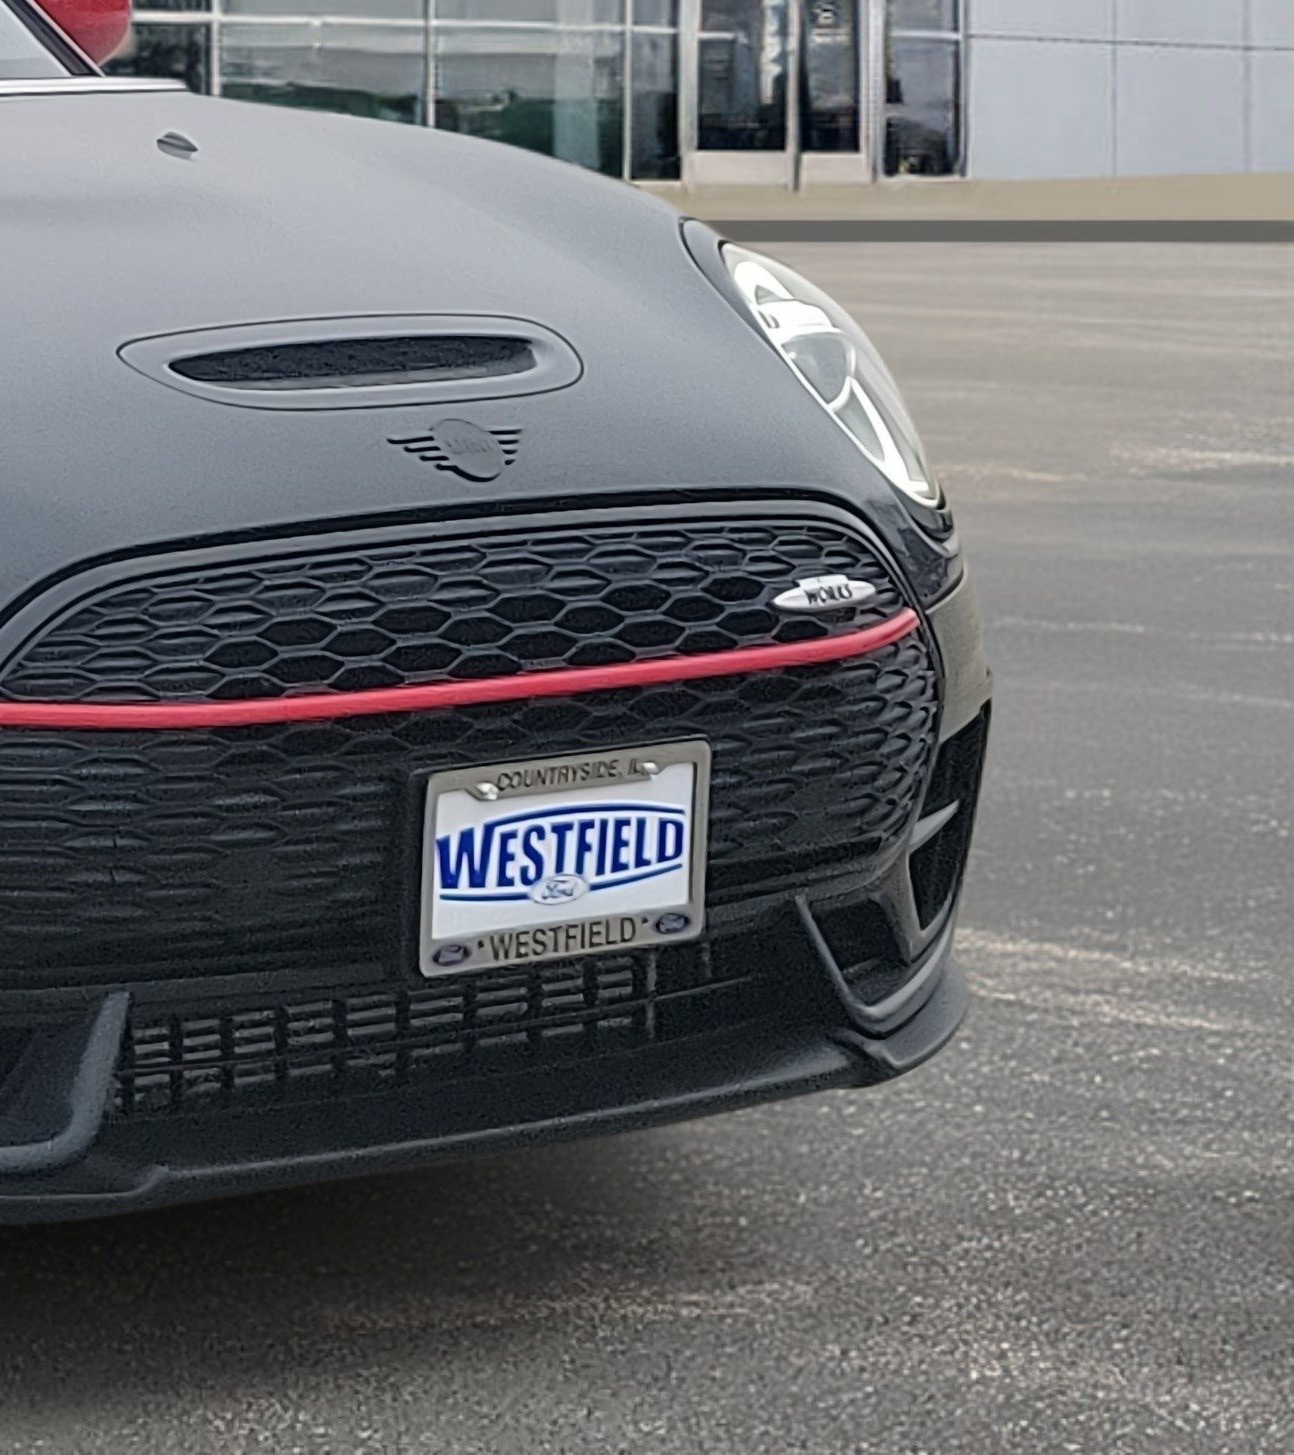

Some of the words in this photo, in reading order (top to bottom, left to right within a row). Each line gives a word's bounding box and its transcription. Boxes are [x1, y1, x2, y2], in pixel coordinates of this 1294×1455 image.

[496, 759, 622, 792] COUNTRYSIDE,
[435, 817, 685, 890] WESTFIELD
[489, 917, 637, 961] WESTFIELD
